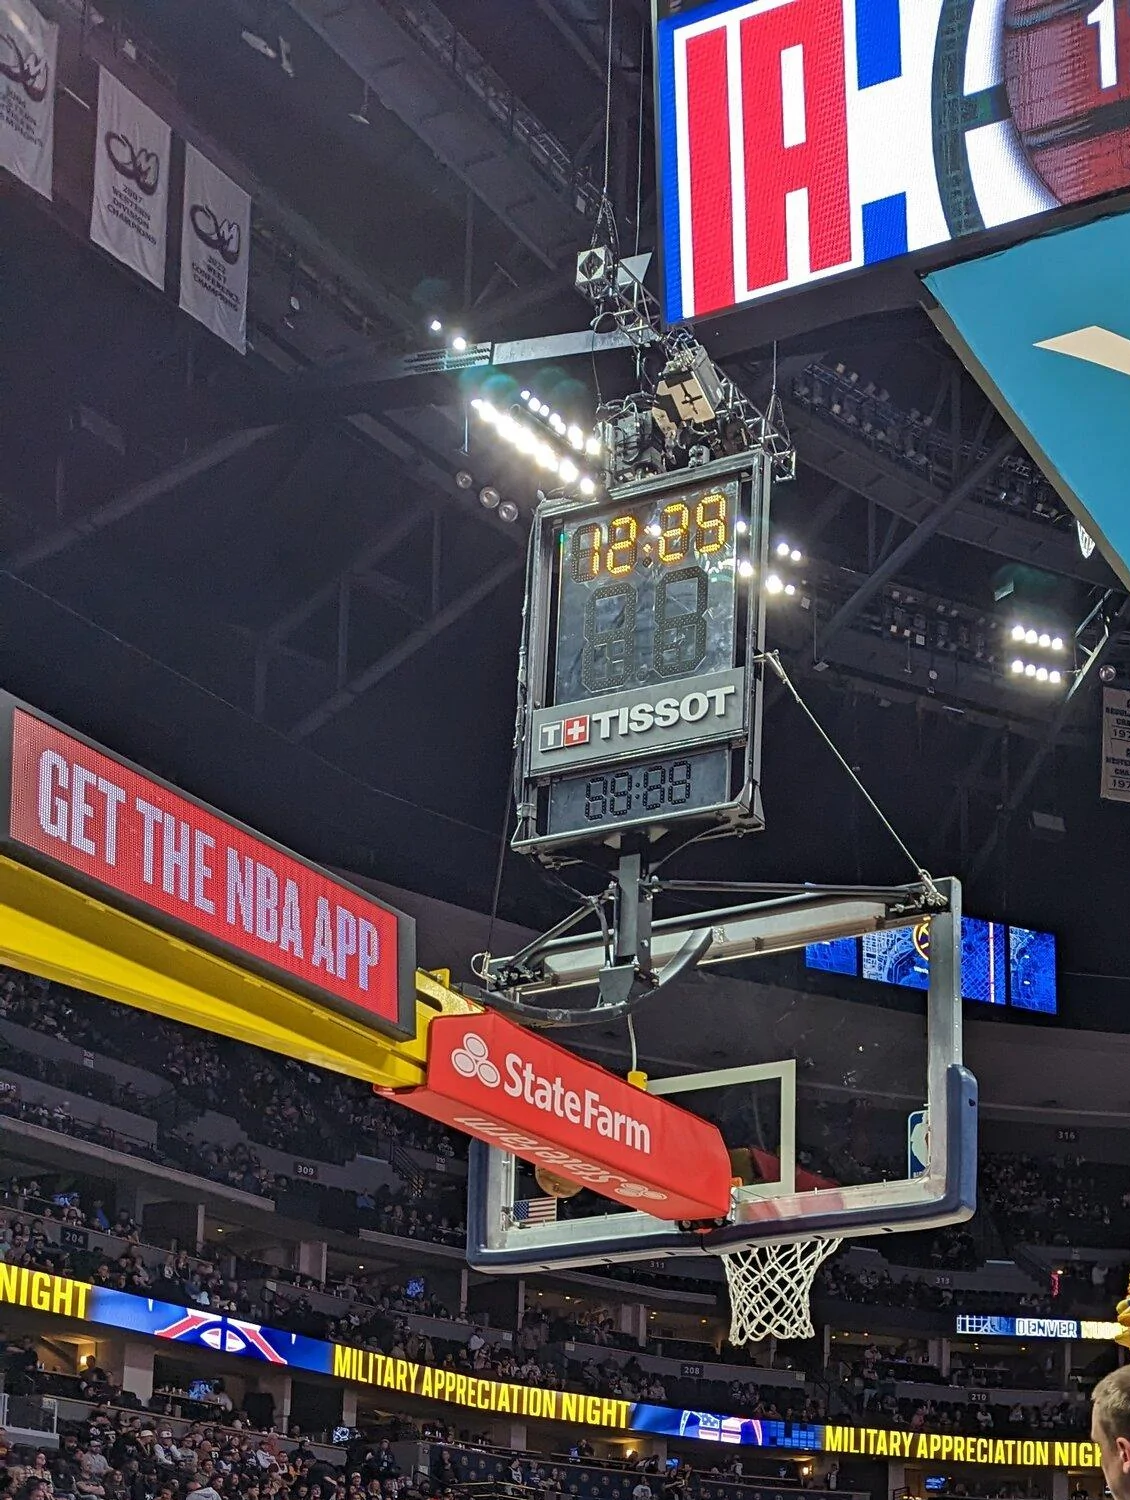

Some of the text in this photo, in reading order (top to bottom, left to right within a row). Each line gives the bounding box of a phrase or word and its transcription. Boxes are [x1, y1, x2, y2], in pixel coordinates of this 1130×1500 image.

[107, 203, 157, 246] CHAMPIONS
[592, 685, 735, 740] TISSOT
[37, 748, 380, 992] GET THE NBA APP
[1058, 1131, 1075, 1139] 316
[64, 1228, 84, 1245] 204
[650, 1261, 665, 1269] 311
[0, 1261, 92, 1321] NIGHT
[1015, 1317, 1078, 1339] DENVER
[333, 1344, 631, 1429] MILITARY APPRECIATION NIGHT
[683, 1366, 700, 1375] 208
[971, 1393, 987, 1401] 210
[825, 1425, 914, 1459] MILITARY
[916, 1433, 1049, 1467] APPRECIATION
